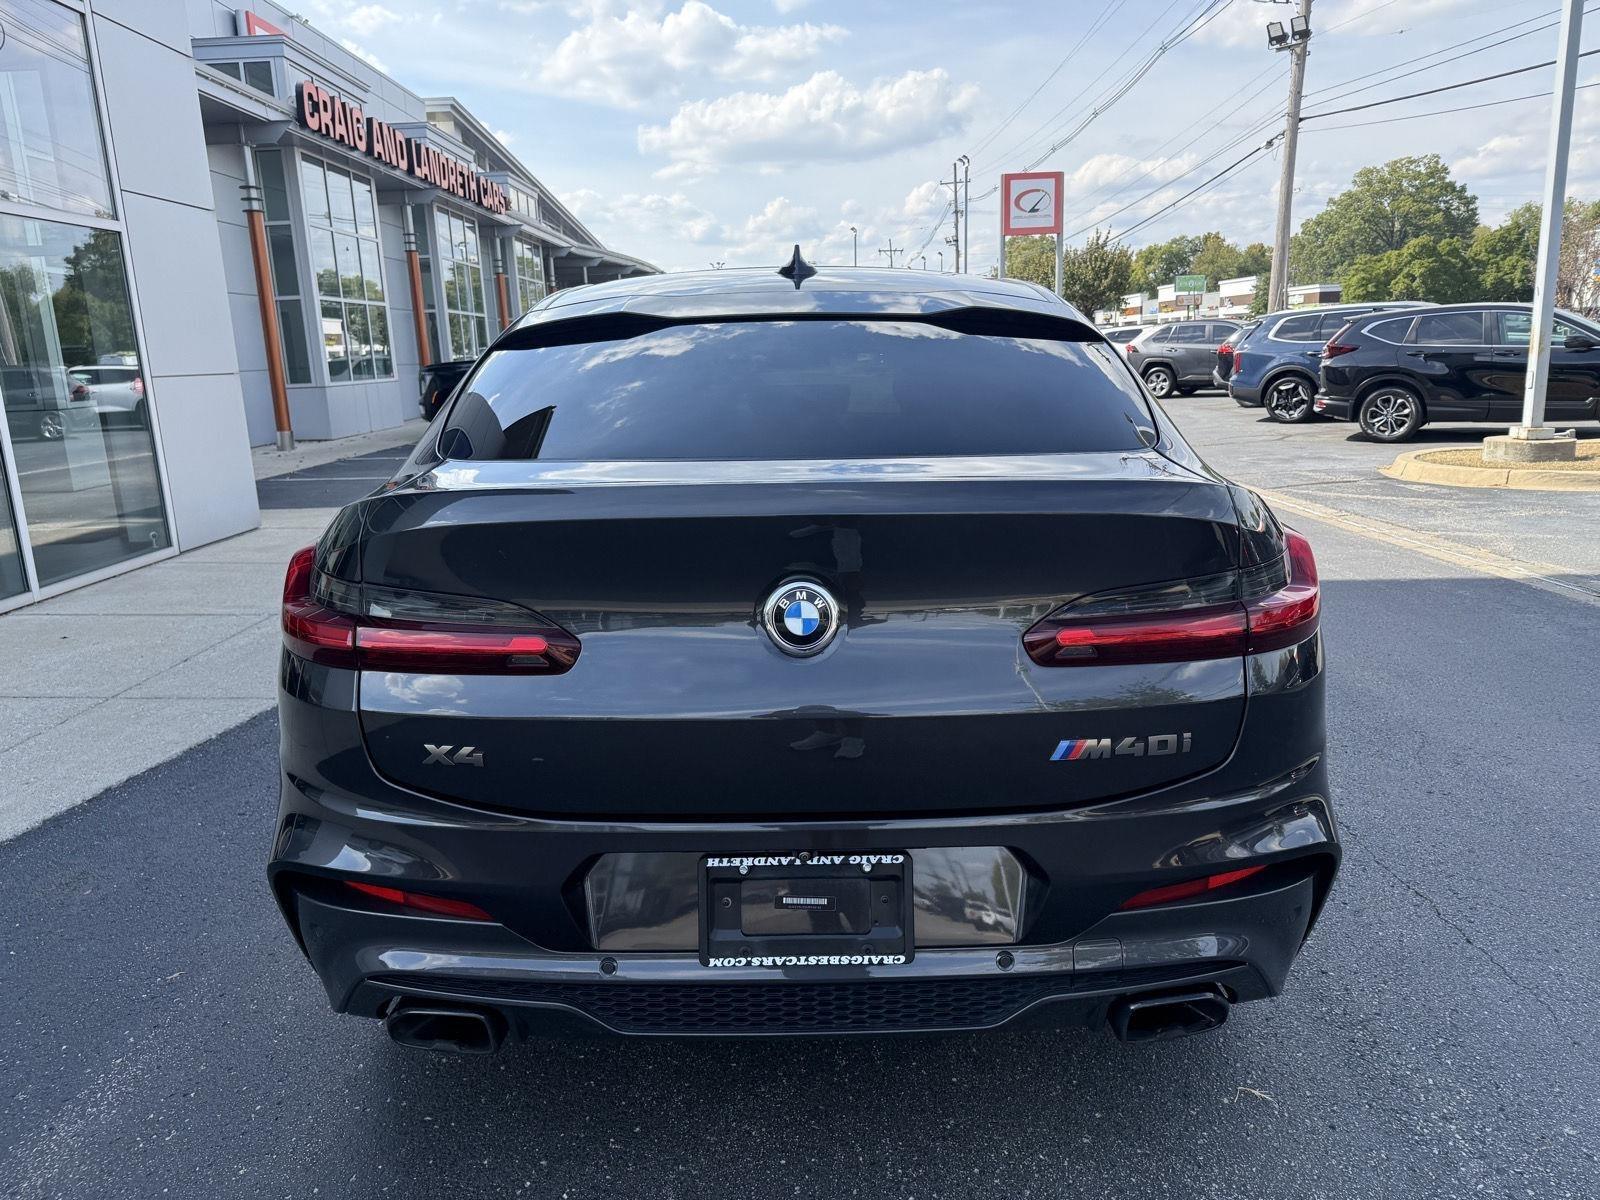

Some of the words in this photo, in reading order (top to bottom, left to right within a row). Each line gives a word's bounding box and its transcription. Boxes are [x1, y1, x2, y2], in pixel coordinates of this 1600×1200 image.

[302, 80, 367, 153] CRAIG
[373, 117, 408, 171] AND
[412, 139, 477, 203] LANDRETH
[479, 176, 506, 215] CARS
[779, 591, 825, 609] BMW
[1072, 732, 1192, 760] M40i
[422, 744, 484, 767] X4
[706, 857, 803, 867] LANDRETH
[849, 855, 905, 866] CRAIG
[709, 955, 905, 967] CRAIGSBESTCARS.COM
